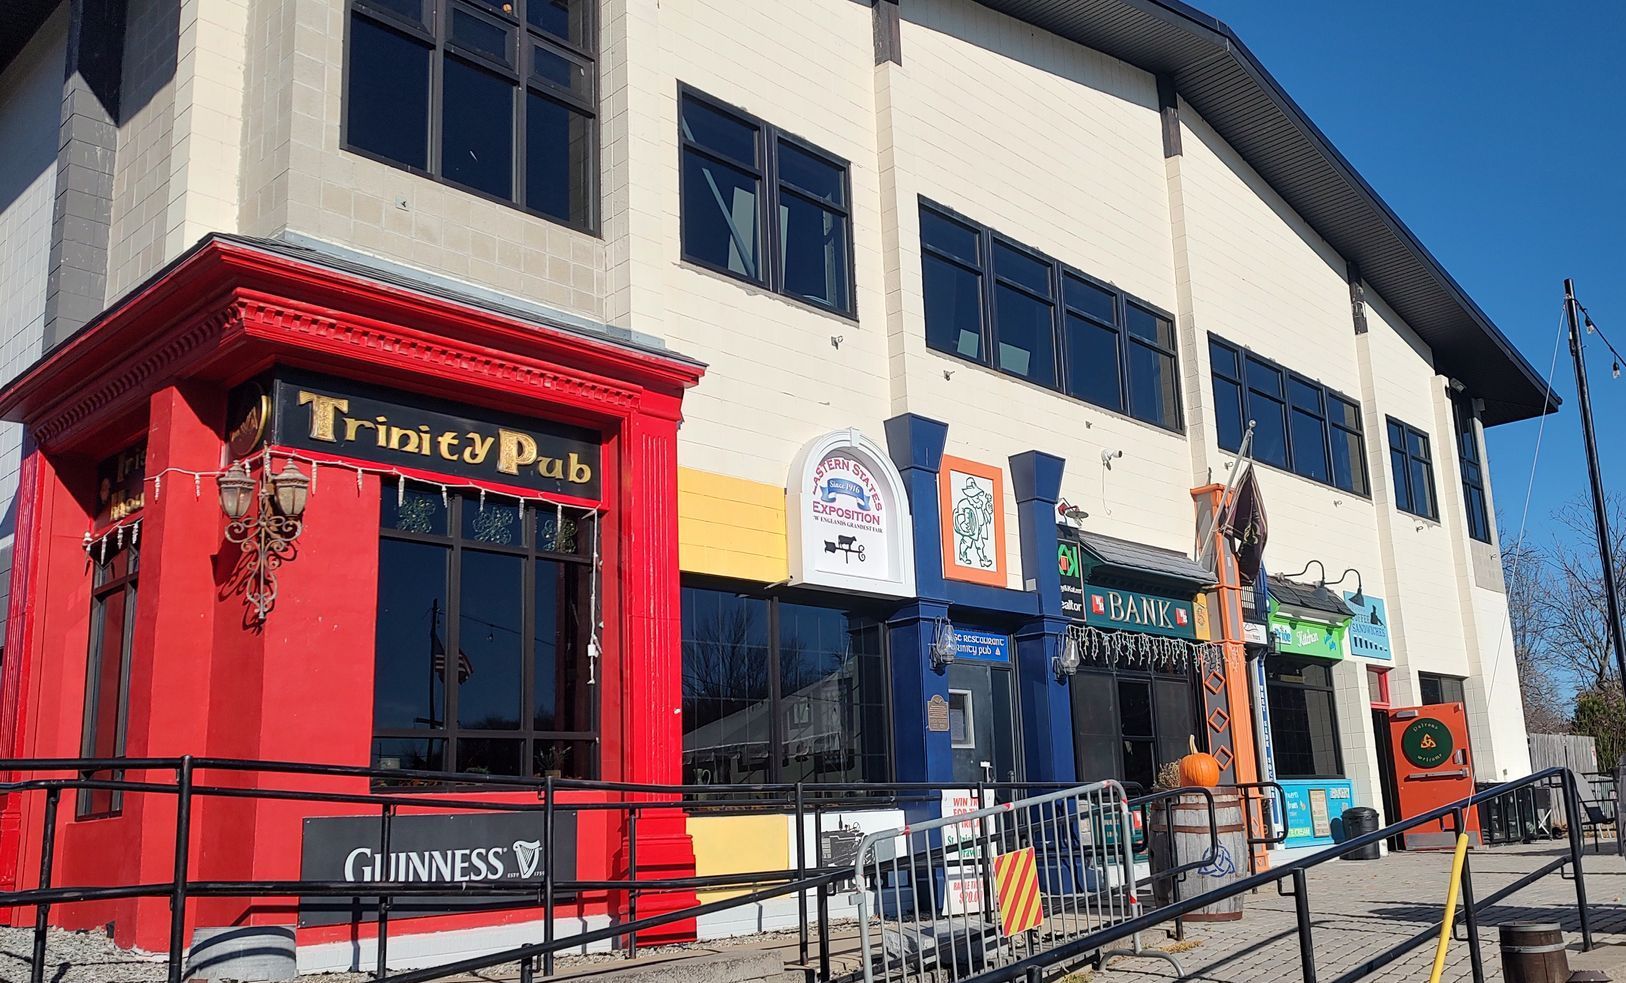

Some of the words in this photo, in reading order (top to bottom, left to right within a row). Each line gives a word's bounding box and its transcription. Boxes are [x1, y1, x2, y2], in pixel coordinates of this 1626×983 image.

[296, 390, 495, 464] Trinity
[496, 427, 592, 483] Pub
[829, 480, 845, 490] Since
[846, 482, 860, 494] 1916
[852, 463, 883, 512] STATES
[812, 500, 880, 526] EXPOSITION
[1061, 599, 1083, 612] ealtor
[1107, 591, 1175, 629] BANK
[953, 797, 968, 807] WIN
[344, 847, 505, 883] GUINNESS
